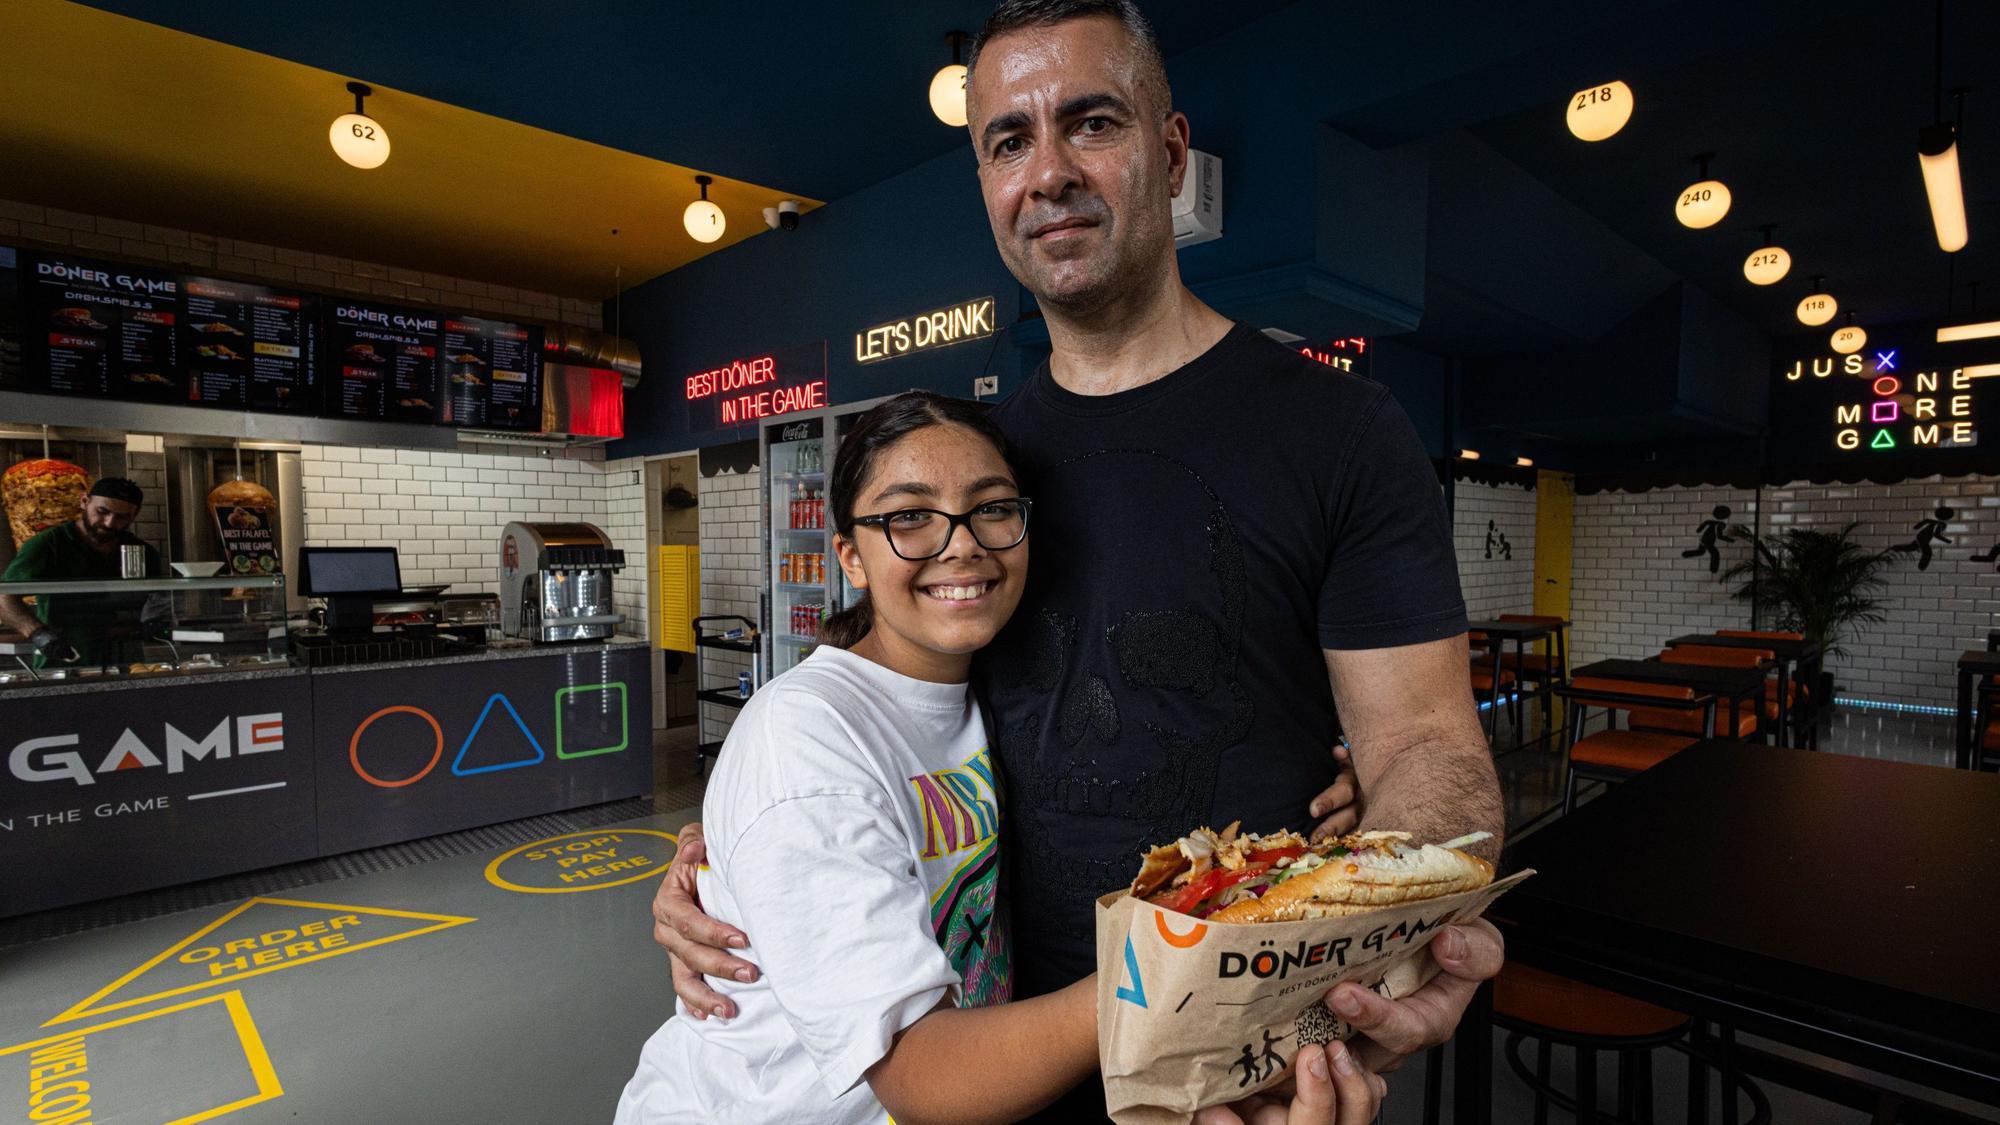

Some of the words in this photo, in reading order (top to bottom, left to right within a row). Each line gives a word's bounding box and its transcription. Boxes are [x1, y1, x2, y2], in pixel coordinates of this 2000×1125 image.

[1577, 87, 1611, 111] 218
[352, 124, 375, 141] 62
[1683, 189, 1712, 207] 240
[710, 214, 716, 225] 1
[1753, 254, 1778, 267] 212
[38, 262, 110, 288] DÖNER
[115, 274, 176, 293] GAME
[337, 306, 389, 327] DÖNER
[393, 316, 438, 331] GAME
[1805, 301, 1825, 311] 118
[856, 321, 910, 362] LET'S
[915, 301, 990, 346] DRINK
[1840, 332, 1853, 341] 20
[687, 370, 720, 400] BEST
[721, 358, 776, 391] DÖNER
[722, 400, 737, 424] IN
[739, 392, 770, 420] THE
[772, 381, 824, 415] GAME
[223, 529, 241, 539] BEST
[240, 542, 252, 551] THE
[253, 542, 273, 551] GAME
[8, 712, 284, 786] GAME
[28, 809, 81, 827] THE
[94, 796, 169, 817] GAME
[525, 835, 623, 860] STOP!
[557, 848, 616, 868] PAY
[559, 856, 653, 882] HERE
[178, 915, 361, 963] ORDER
[209, 933, 349, 976] HERE
[1218, 937, 1352, 979] DÖNER
[1278, 983, 1303, 997] BEST
[1304, 972, 1338, 988] DÖNER
